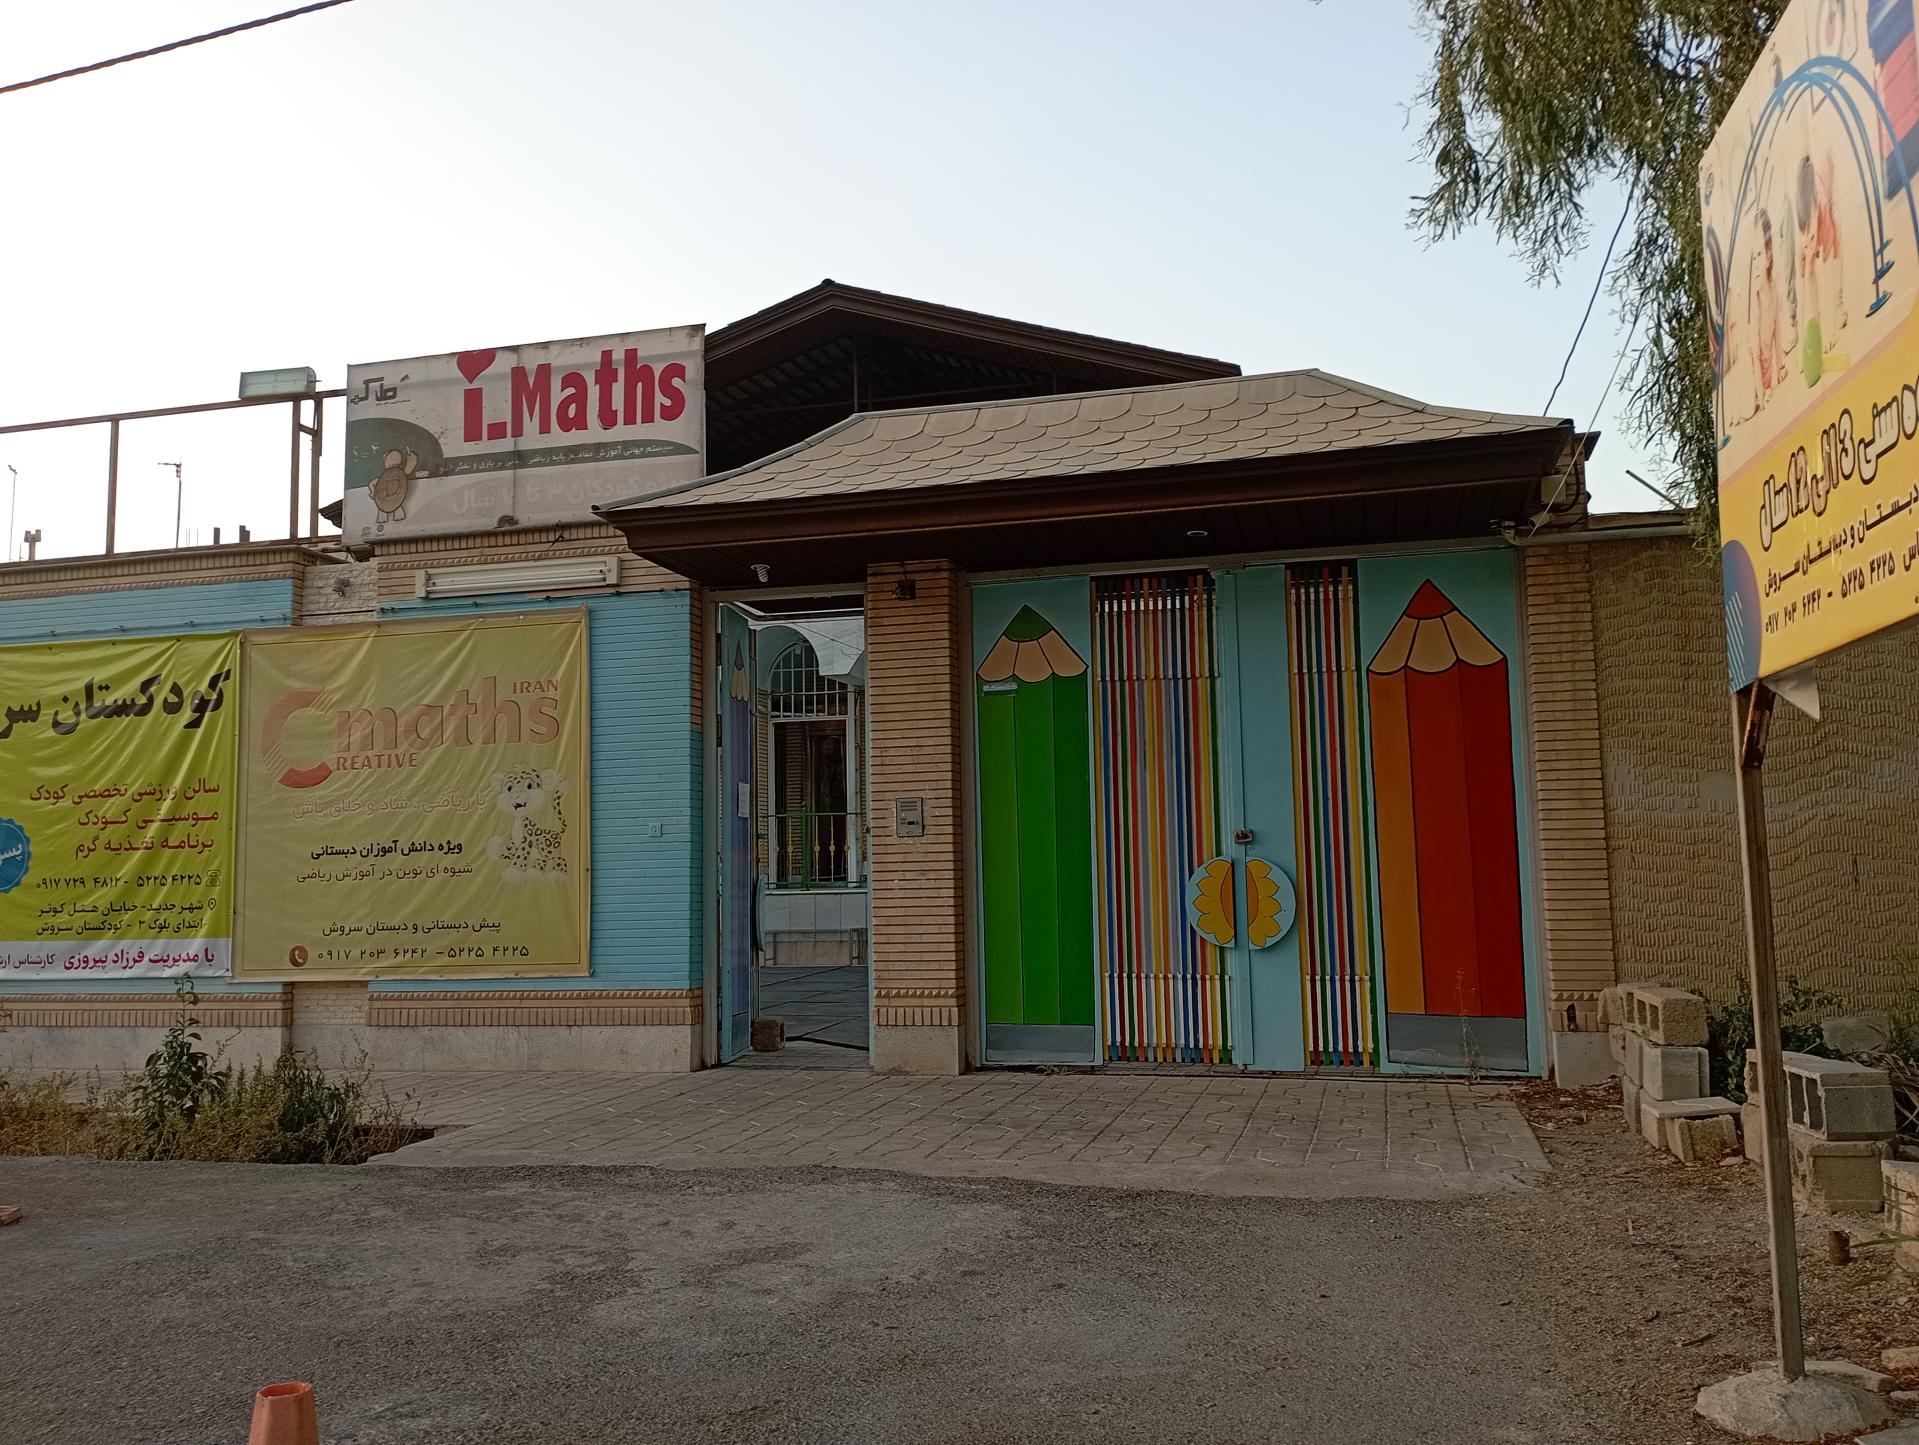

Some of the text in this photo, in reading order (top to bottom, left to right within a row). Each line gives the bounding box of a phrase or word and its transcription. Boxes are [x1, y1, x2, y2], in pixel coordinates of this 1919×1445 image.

[646, 444, 673, 453] سیستم
[1839, 408, 1855, 480] 3
[1858, 395, 1900, 485] سنی
[597, 446, 622, 458] آموزش
[623, 447, 644, 456] جهانی
[480, 458, 494, 469] بازی
[1811, 422, 1839, 517] الی
[1788, 446, 1810, 518] 12
[452, 488, 495, 514] سال
[1760, 474, 1789, 552] سال
[1850, 524, 1855, 549] و
[1802, 527, 1847, 576] دبستان
[1764, 560, 1800, 598] سروش
[1841, 566, 1865, 599] ۵۲۲۵
[1869, 551, 1896, 585] ۴۲۲۵
[512, 678, 559, 695] IRAN
[51, 668, 232, 735] کودکستان
[30, 777, 220, 805] سالن ورزشی تخصصی کودک
[292, 799, 325, 819] باش
[329, 797, 362, 817] خلاق
[366, 800, 375, 816] و
[380, 795, 408, 811] شاد
[475, 793, 486, 811] با
[78, 808, 219, 830] موسیقی کودک
[75, 834, 99, 859] گرم
[161, 833, 214, 854] برنامه
[311, 839, 463, 860] ویژه دانش آموزان دبستانی
[36, 877, 61, 889] ۰۹۱۷
[137, 875, 168, 887] ۵۲۲۵
[171, 873, 202, 886] ۴۲۲۵
[296, 862, 473, 883] شیوه ای نوین در آموزش ریاضی
[68, 902, 99, 917] هتل
[101, 901, 138, 916] خیابان
[177, 901, 204, 914] شهر
[36, 922, 74, 936] سروش
[75, 919, 124, 935] کودکستان
[148, 918, 170, 934] بلوک
[173, 917, 203, 933] ابتدای
[322, 918, 501, 937] پیش دبستانی و دبستان سروش
[13, 953, 56, 969] کارشناس
[64, 952, 108, 971] پیروزی
[112, 947, 145, 970] فرزاد
[148, 951, 200, 970] مدیریت
[204, 947, 215, 967] با
[317, 949, 352, 961] ۰۹۱۷
[360, 947, 386, 959] ۲۰۳
[393, 947, 427, 960] ۶۲۴۲
[447, 946, 485, 958] ۵۲۲۵
[492, 945, 529, 957] ۴۲۲۵
